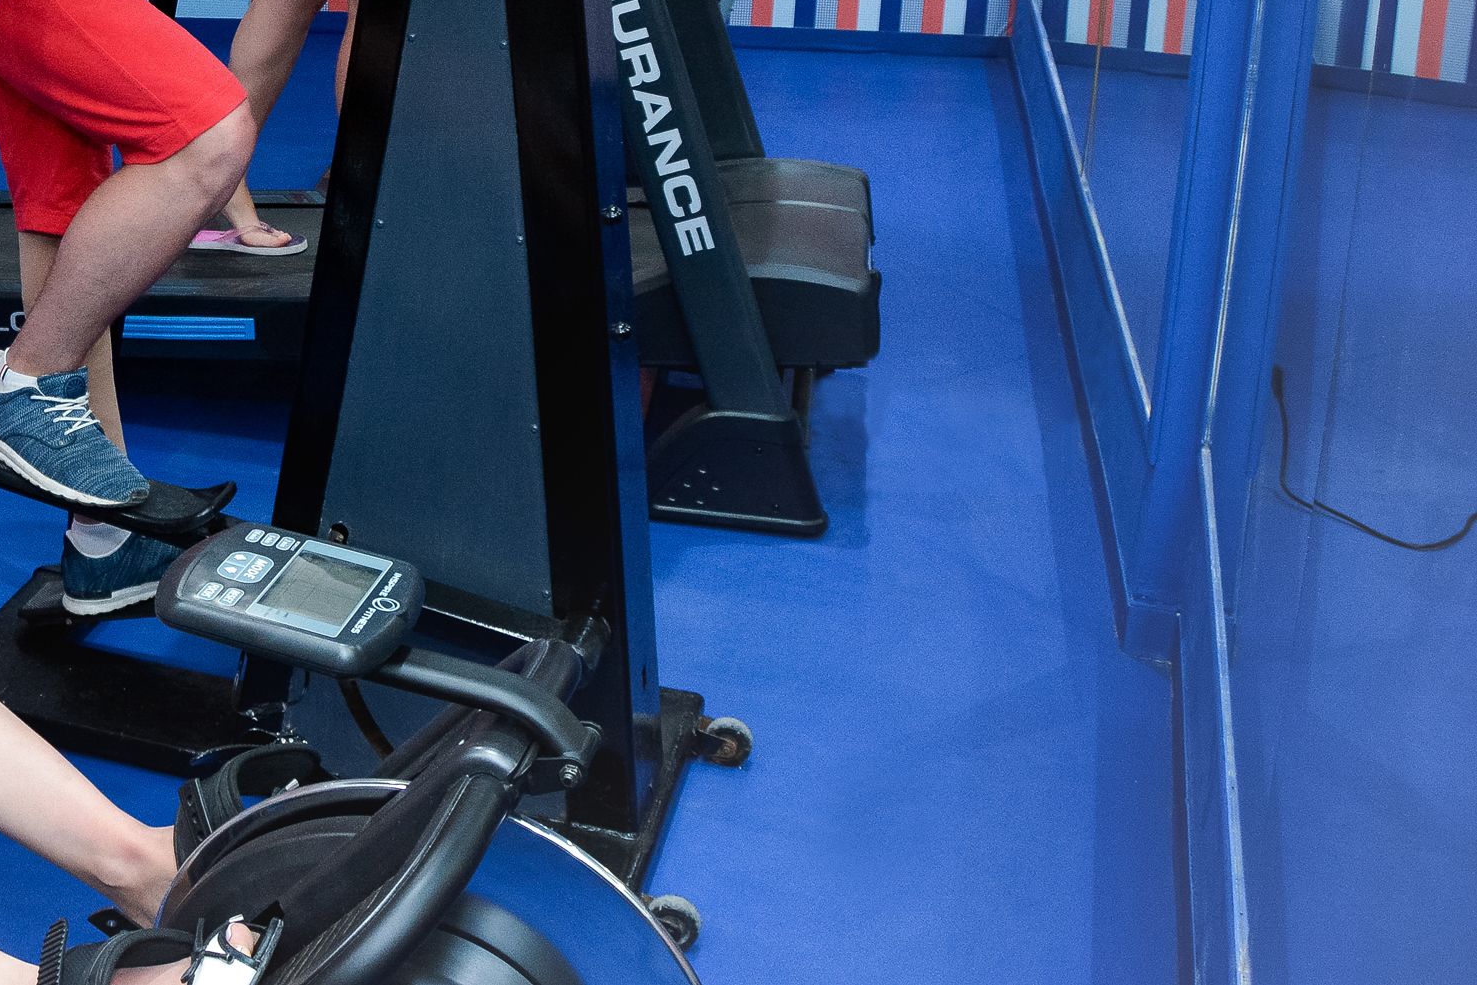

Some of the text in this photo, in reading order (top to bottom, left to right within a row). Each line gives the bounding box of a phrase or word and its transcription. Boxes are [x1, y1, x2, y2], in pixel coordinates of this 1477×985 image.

[244, 558, 269, 580] MODE
[350, 572, 403, 635] INSPIRE FITNESS
